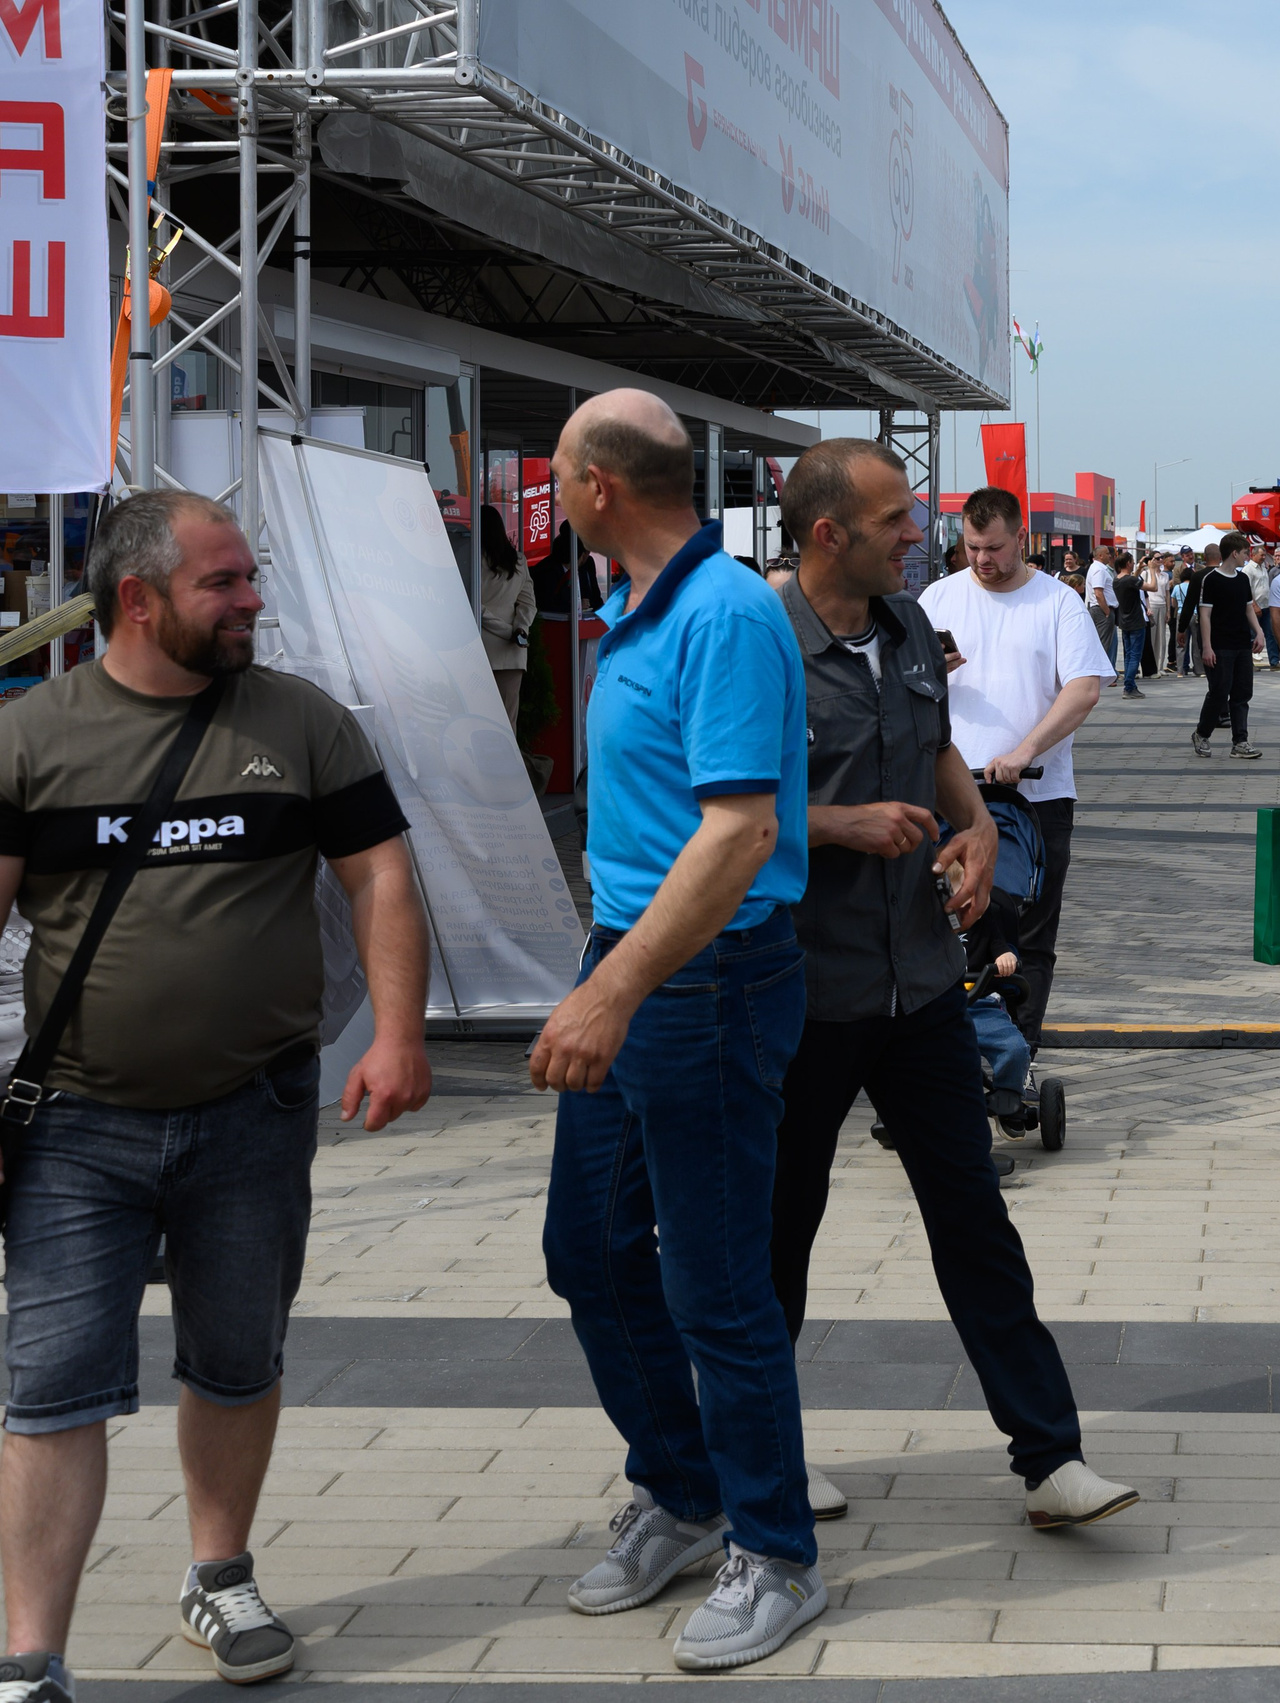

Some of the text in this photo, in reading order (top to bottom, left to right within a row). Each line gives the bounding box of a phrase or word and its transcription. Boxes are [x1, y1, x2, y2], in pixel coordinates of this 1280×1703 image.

[713, 2, 772, 92] лидеров
[775, 63, 842, 159] агробизнеса
[97, 814, 246, 847] Kppa
[168, 844, 190, 854] DOLOR
[191, 843, 203, 852] SIT
[203, 842, 223, 851] AMET
